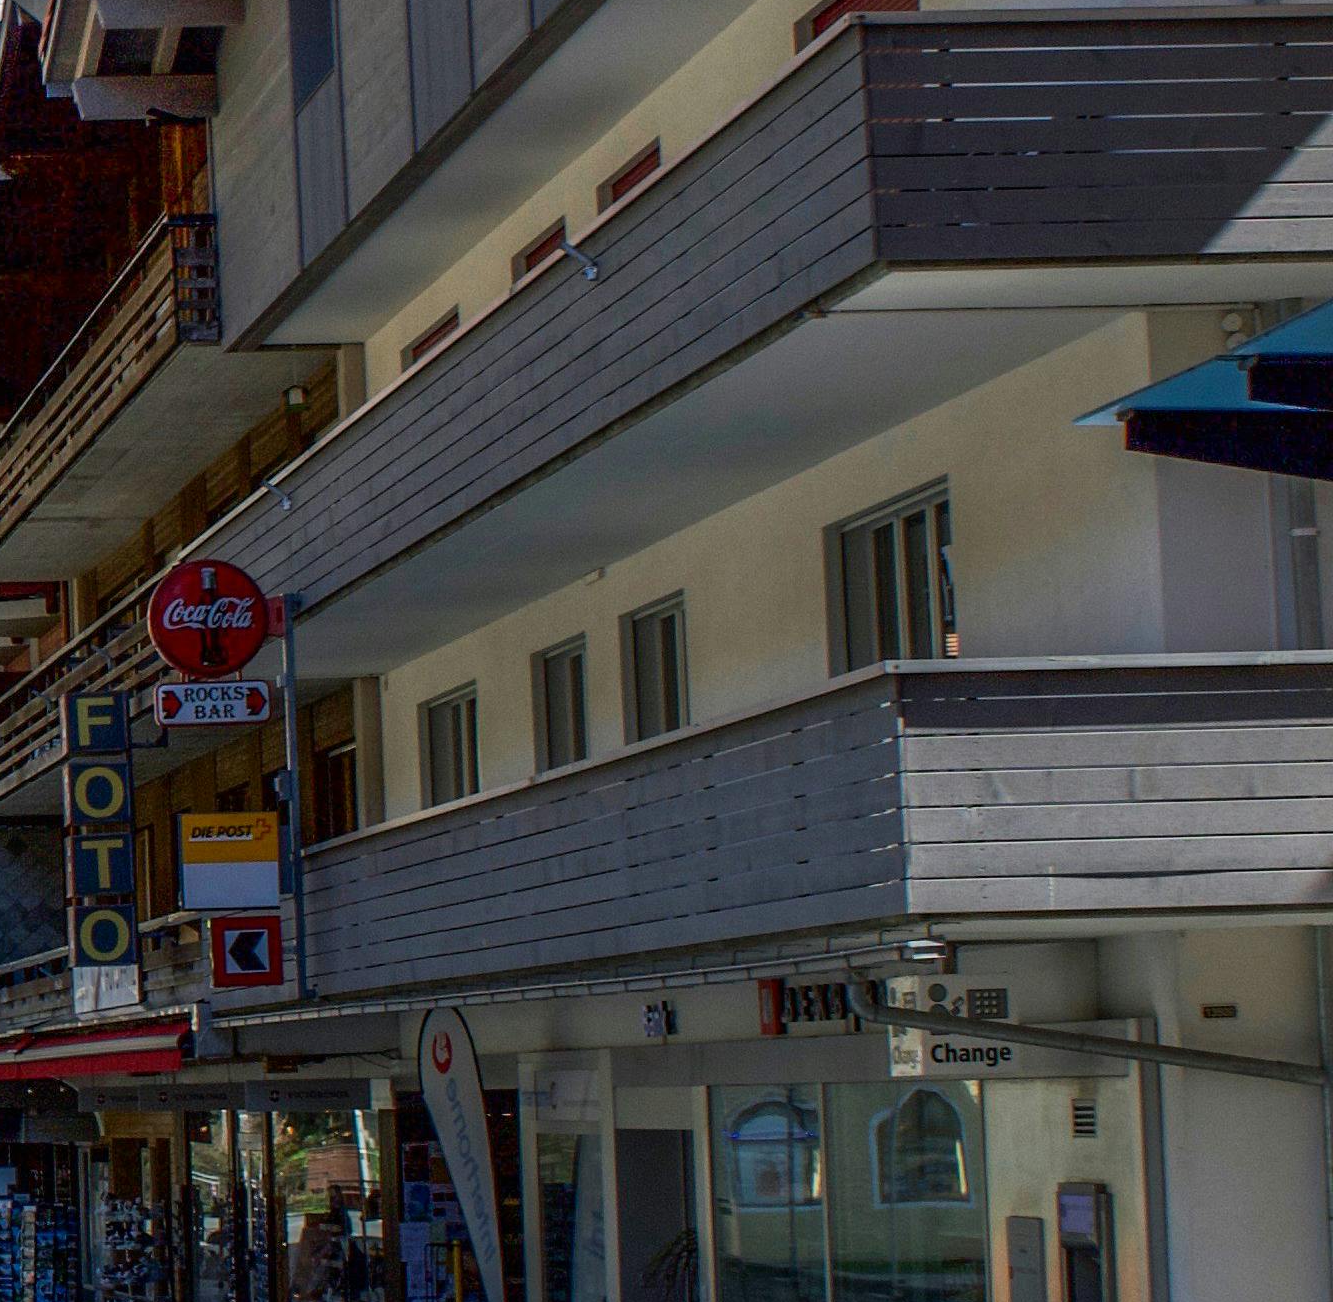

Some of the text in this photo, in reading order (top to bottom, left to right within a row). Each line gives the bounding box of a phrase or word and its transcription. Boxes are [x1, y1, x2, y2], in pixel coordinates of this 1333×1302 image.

[162, 597, 255, 630] Coca-Cola
[183, 685, 245, 703] ROCKS
[194, 704, 236, 720] BAR
[74, 697, 131, 962] FOTO
[191, 824, 254, 839] DIE POST
[931, 1043, 1012, 1067] Change
